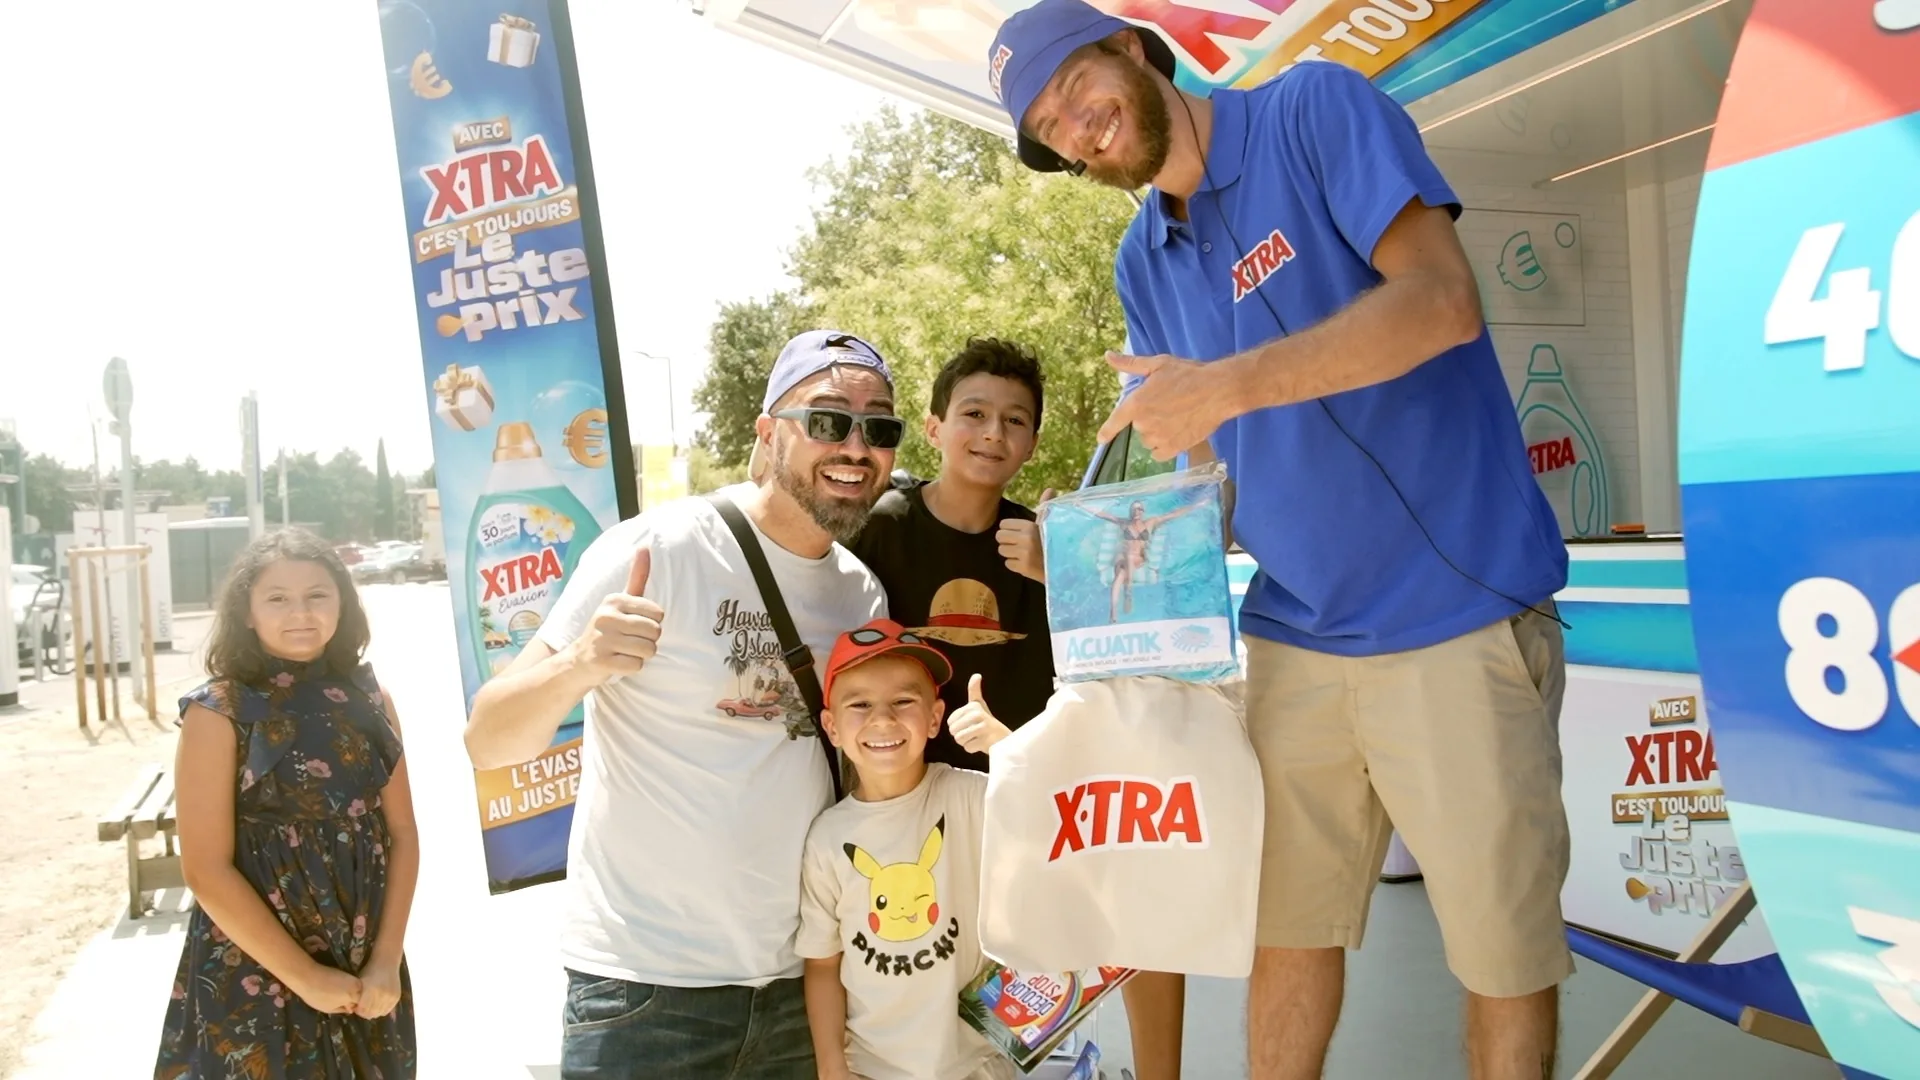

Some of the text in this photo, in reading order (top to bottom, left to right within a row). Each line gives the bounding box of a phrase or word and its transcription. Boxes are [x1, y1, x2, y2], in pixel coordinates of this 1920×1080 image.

[1321, 0, 1450, 56] TOU
[459, 122, 504, 144] AVEC
[418, 199, 573, 255] C'EST TOUJOURS
[454, 232, 514, 269] Le
[426, 248, 590, 308] Juste
[459, 286, 585, 342] prix
[482, 526, 499, 542] 30
[713, 599, 773, 635] Hawa
[733, 629, 783, 660] Islan
[1654, 700, 1690, 719] AVEC
[488, 773, 580, 822] AU JUSTE
[1615, 798, 1657, 816] C'EST
[1642, 810, 1691, 842] Le
[1619, 836, 1748, 882] Juste
[852, 917, 959, 976] PIKACHU
[1027, 975, 1061, 997] STOP
